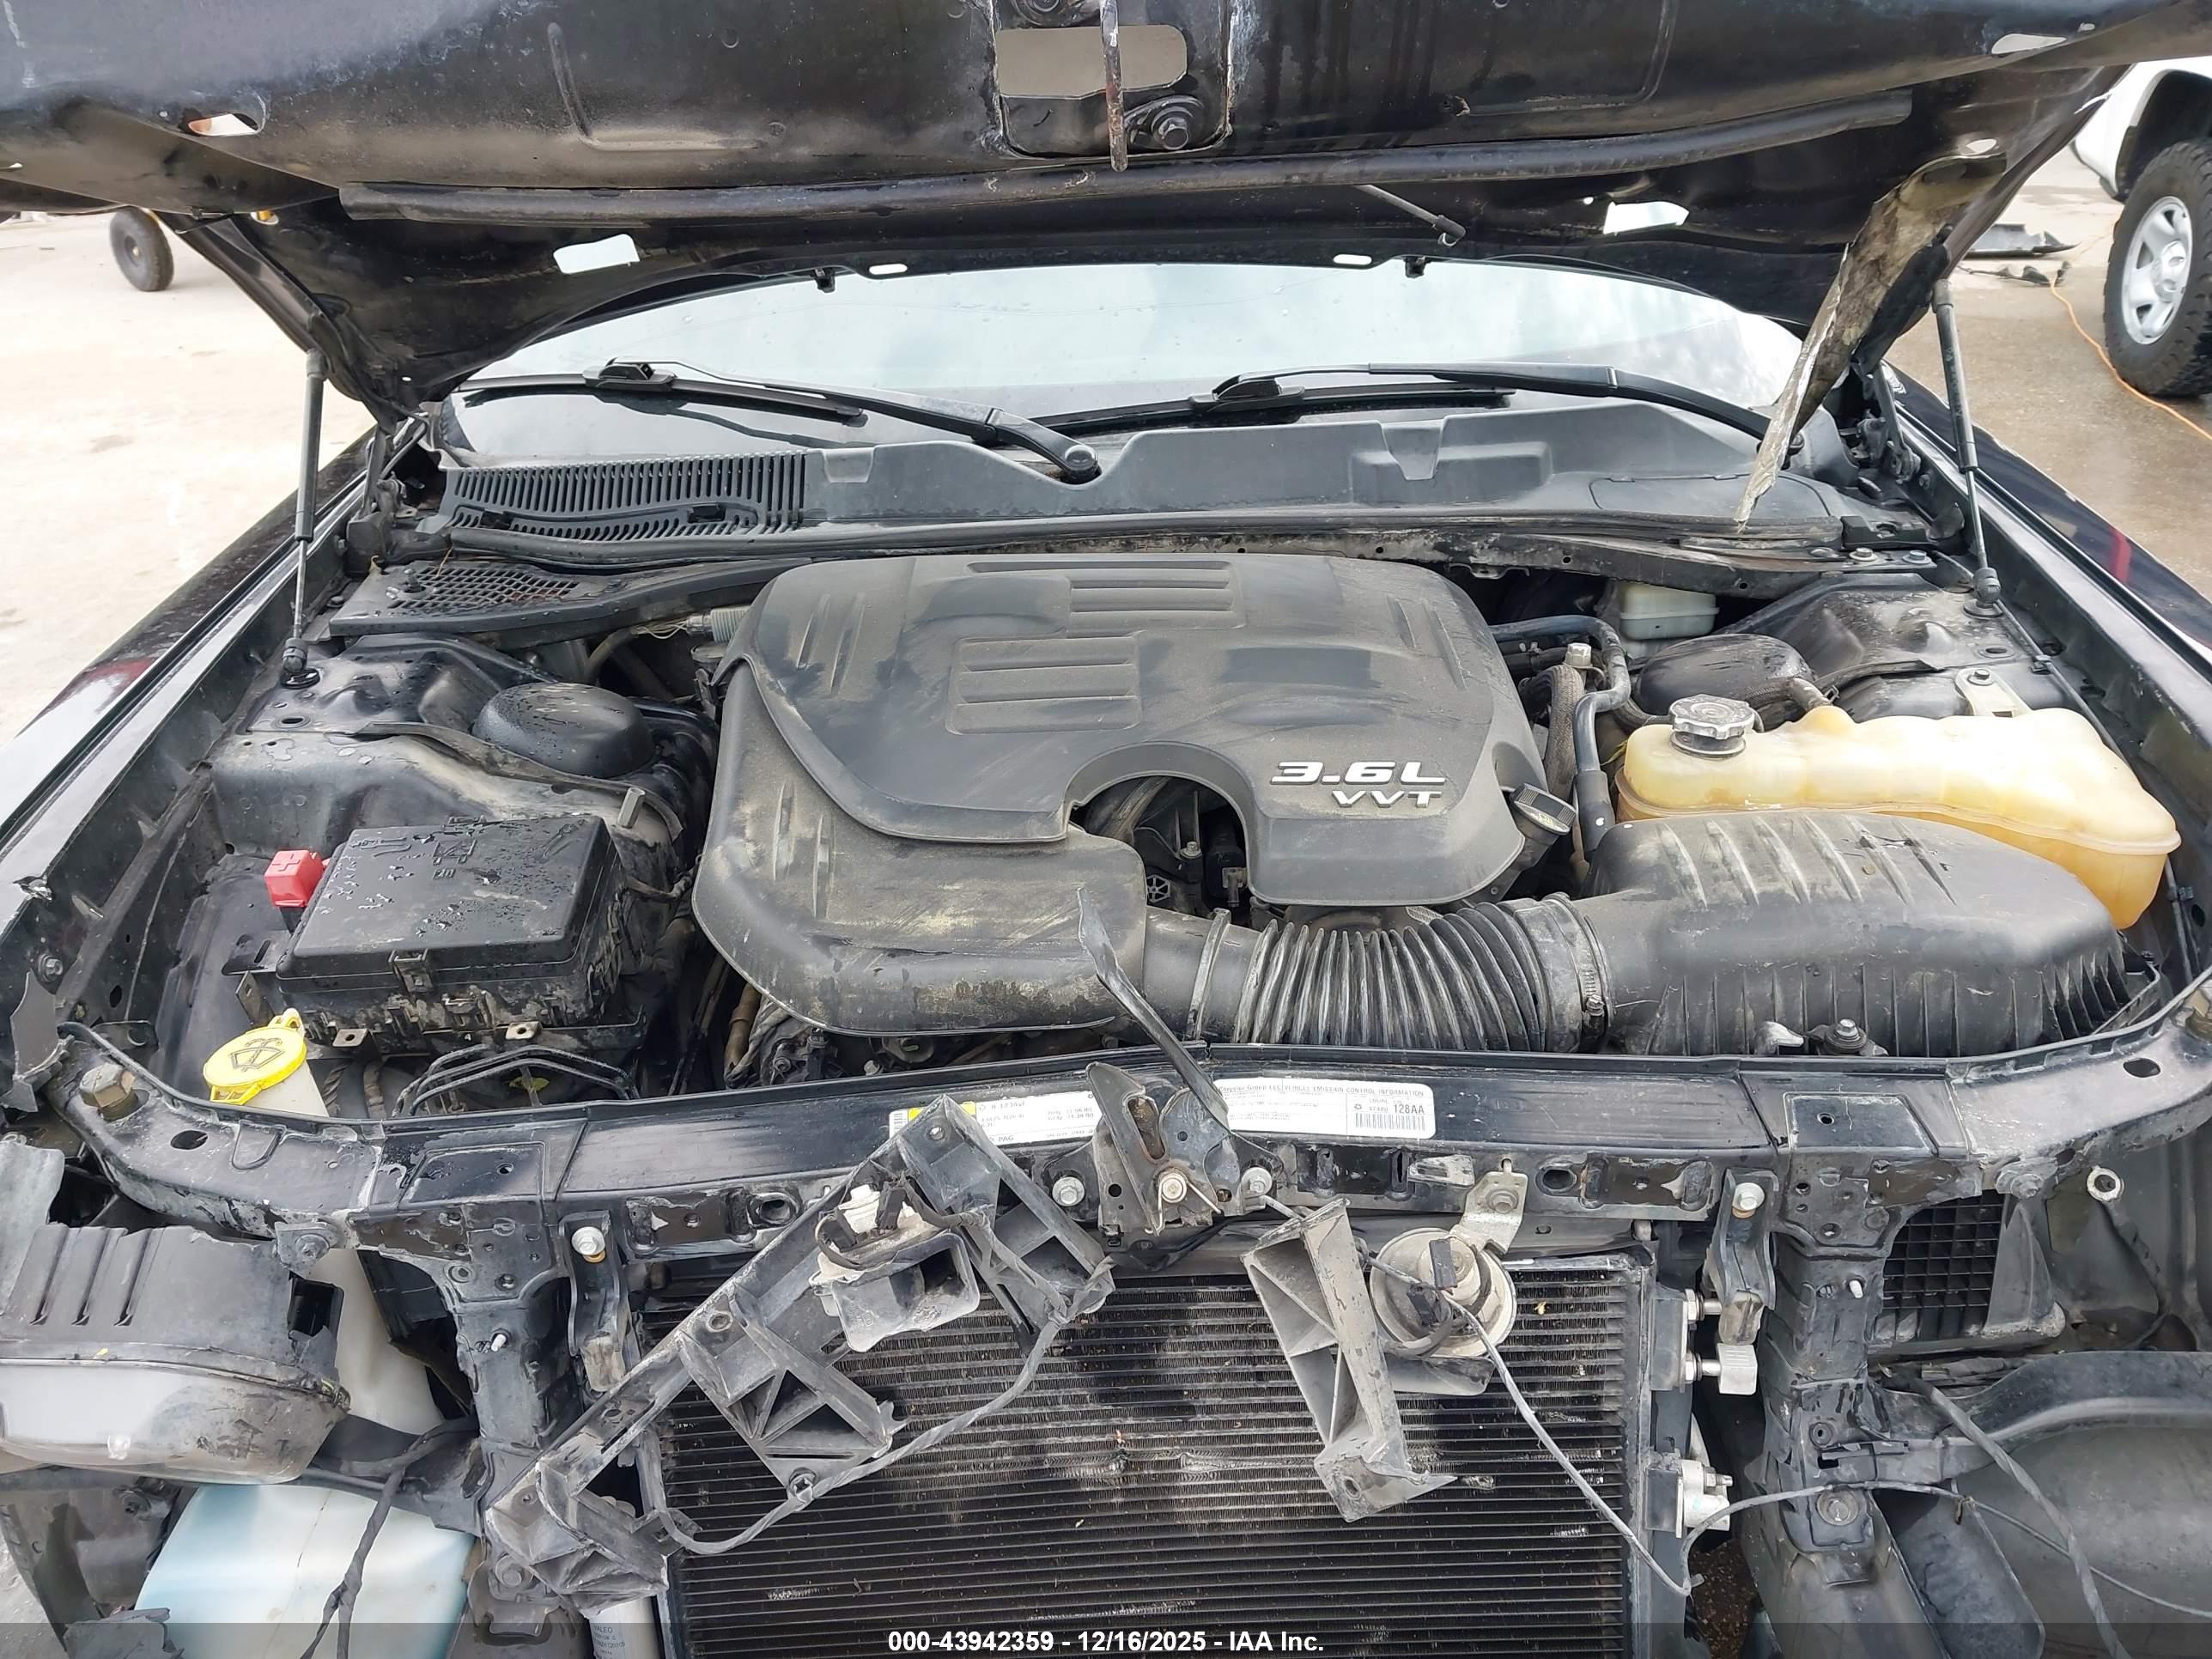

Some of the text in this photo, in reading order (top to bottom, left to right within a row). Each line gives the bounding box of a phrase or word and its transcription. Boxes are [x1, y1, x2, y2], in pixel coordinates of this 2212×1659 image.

[1270, 762, 1446, 785] 3.6L
[1332, 790, 1442, 808] VVT
[1378, 1088, 1425, 1097] INFORMATION
[1394, 1103, 1425, 1114] 128AA
